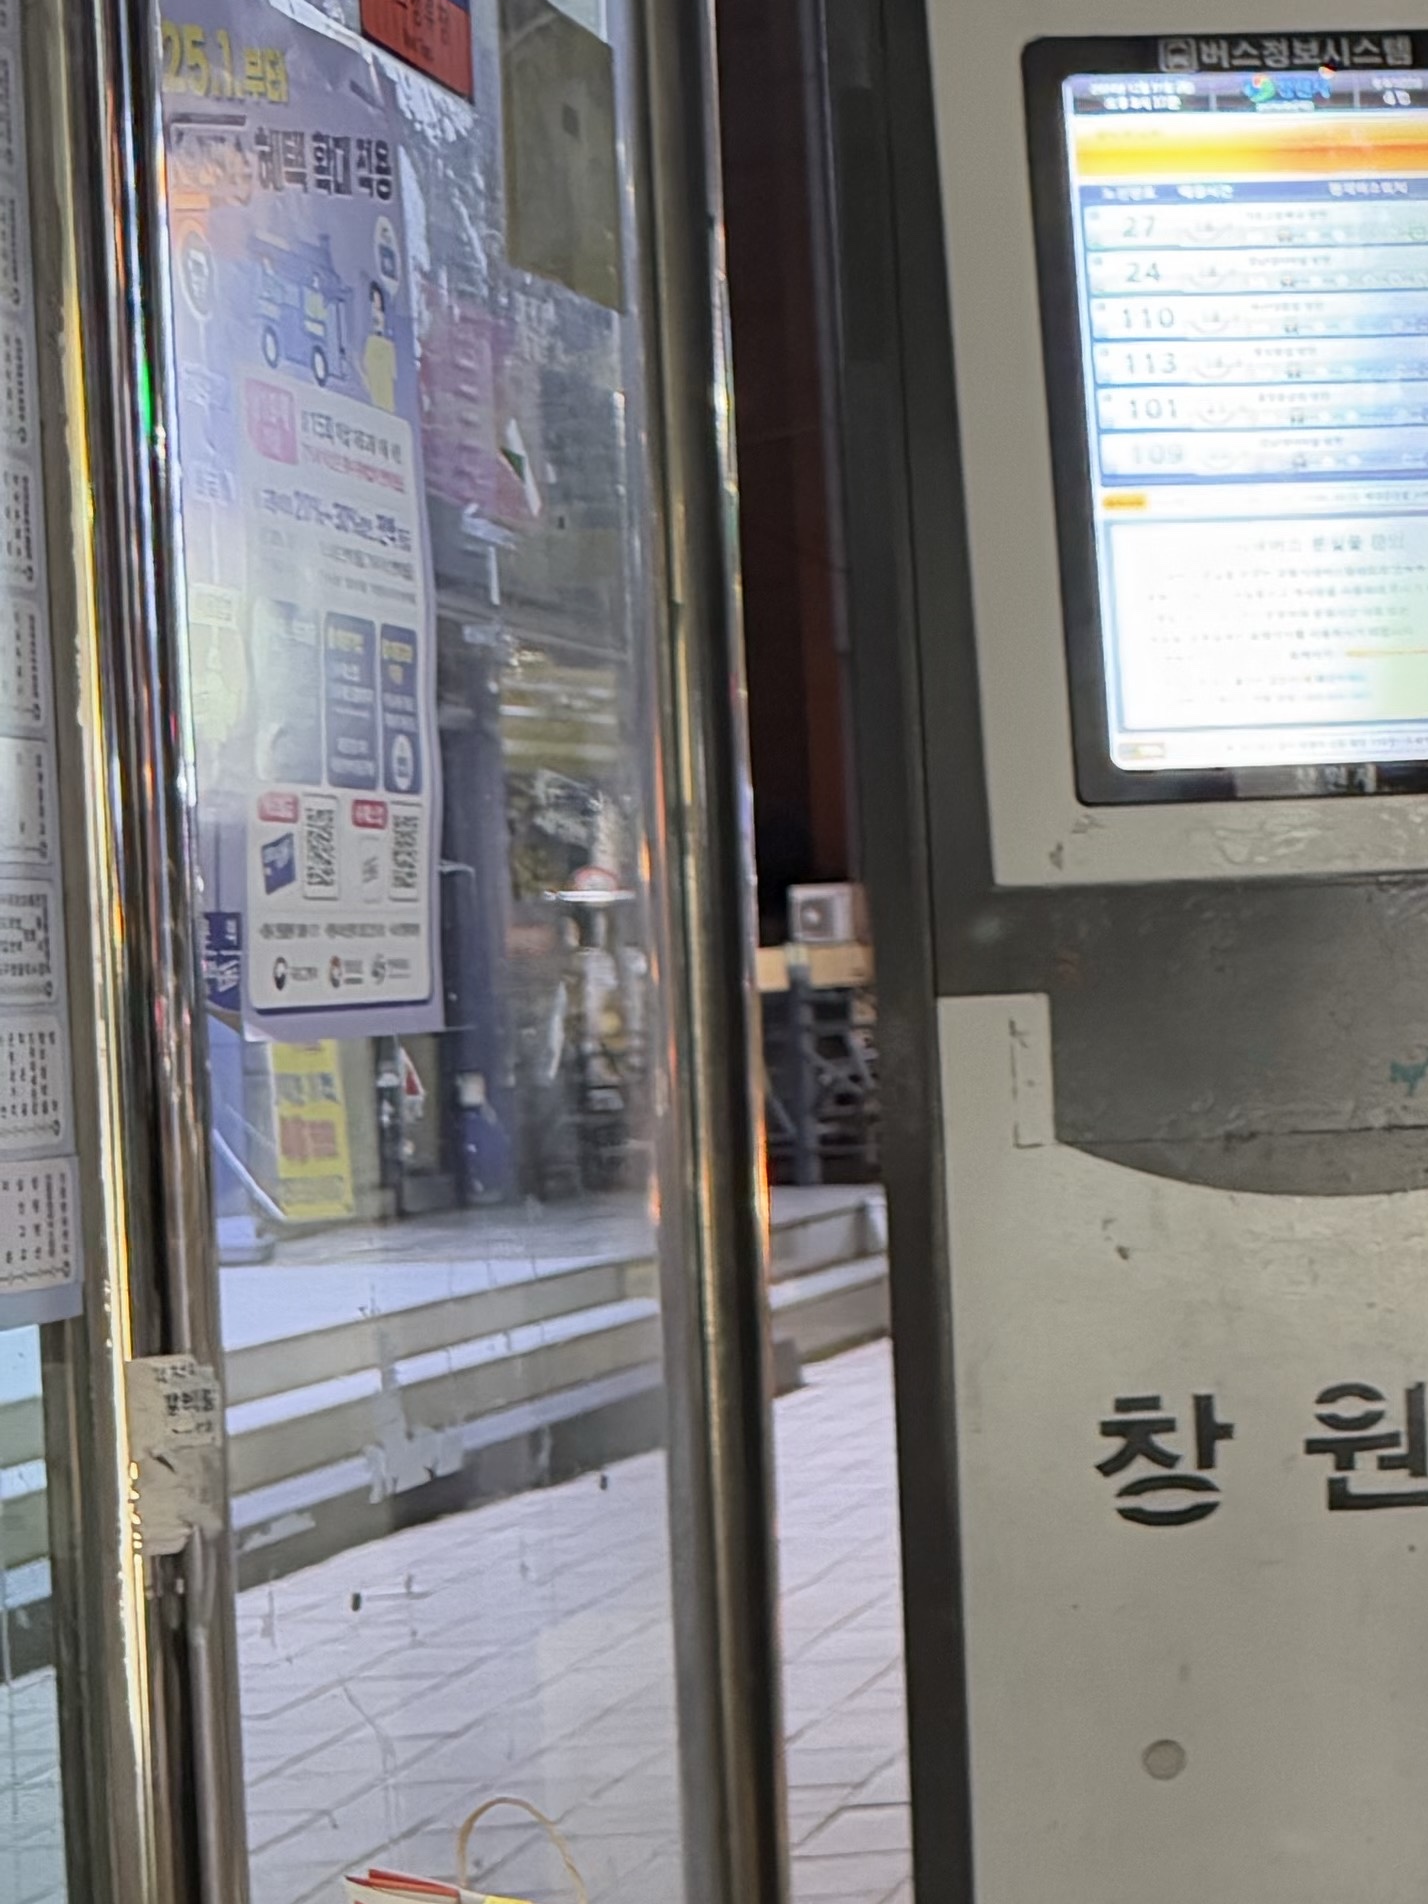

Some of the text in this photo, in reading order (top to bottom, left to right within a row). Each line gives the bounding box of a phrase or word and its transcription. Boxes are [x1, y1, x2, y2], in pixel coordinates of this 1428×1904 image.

[1200, 35, 1414, 69] 버스정보시스템
[1122, 215, 1156, 238] 27
[1125, 261, 1162, 283] 24
[1123, 307, 1176, 329] 110
[1126, 352, 1178, 375] 113
[1130, 397, 1179, 420] 101
